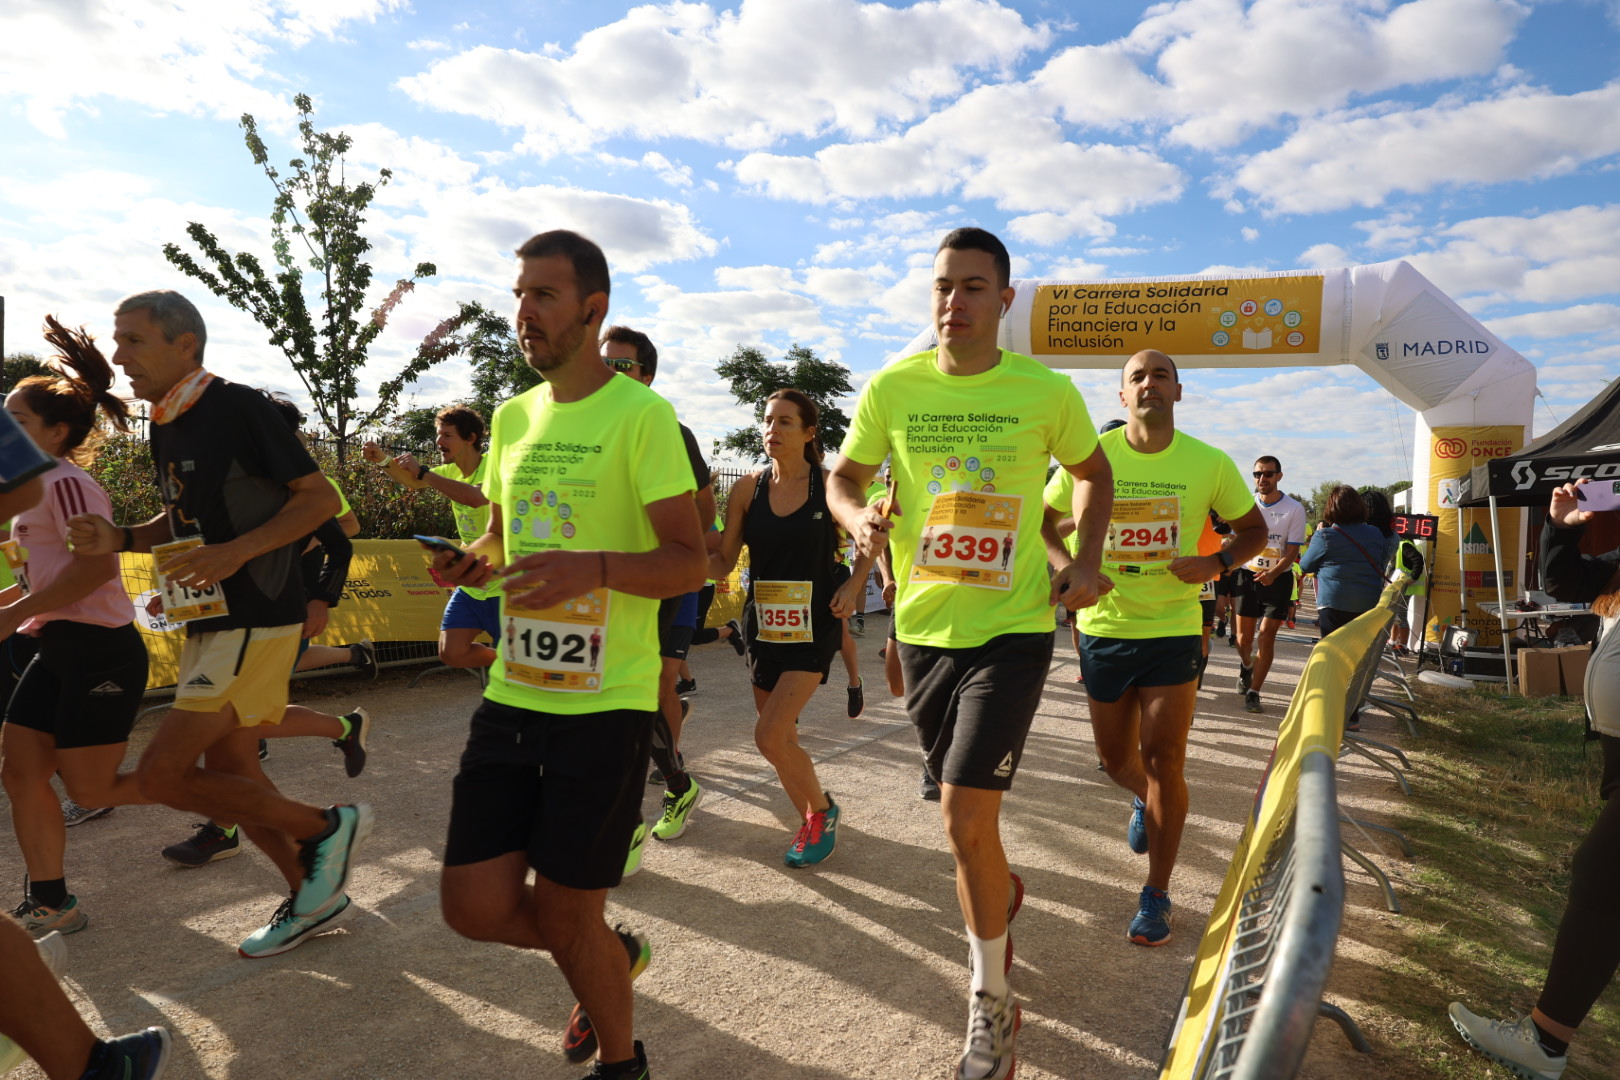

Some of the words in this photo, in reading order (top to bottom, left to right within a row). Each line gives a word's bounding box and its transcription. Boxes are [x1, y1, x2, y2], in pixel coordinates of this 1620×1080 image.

[1052, 289, 1068, 300] VI
[1073, 288, 1141, 300] Carrera
[1145, 285, 1229, 299] Solidaria
[1048, 304, 1078, 317] por
[1082, 302, 1098, 315] la
[1104, 299, 1201, 315] Educación
[1048, 317, 1138, 332] Financiera
[1144, 320, 1154, 335] y
[1159, 316, 1176, 332] la
[1048, 334, 1124, 348] Inclusión
[1403, 340, 1489, 357] MADRID
[907, 413, 918, 423] VI
[921, 413, 965, 423] Carrera
[967, 412, 1019, 424] Solidaria
[906, 425, 925, 434] por
[928, 423, 938, 433] la
[942, 423, 1003, 433] Educación
[906, 433, 964, 443] Financiera
[967, 436, 974, 445] y
[977, 433, 988, 443] la
[1471, 438, 1513, 446] Fundación
[554, 442, 602, 454] Solidaria
[906, 443, 955, 453] Inclusión
[1470, 446, 1512, 457] ONCE
[531, 452, 584, 464] Educación
[1116, 479, 1148, 488] Carrera
[1150, 481, 1187, 491] Solidaria
[1131, 487, 1176, 497] Educación
[1120, 527, 1169, 547] 294
[933, 532, 999, 563] 339
[350, 588, 392, 599] Todos
[764, 609, 801, 627] 355
[520, 628, 586, 664] 192
